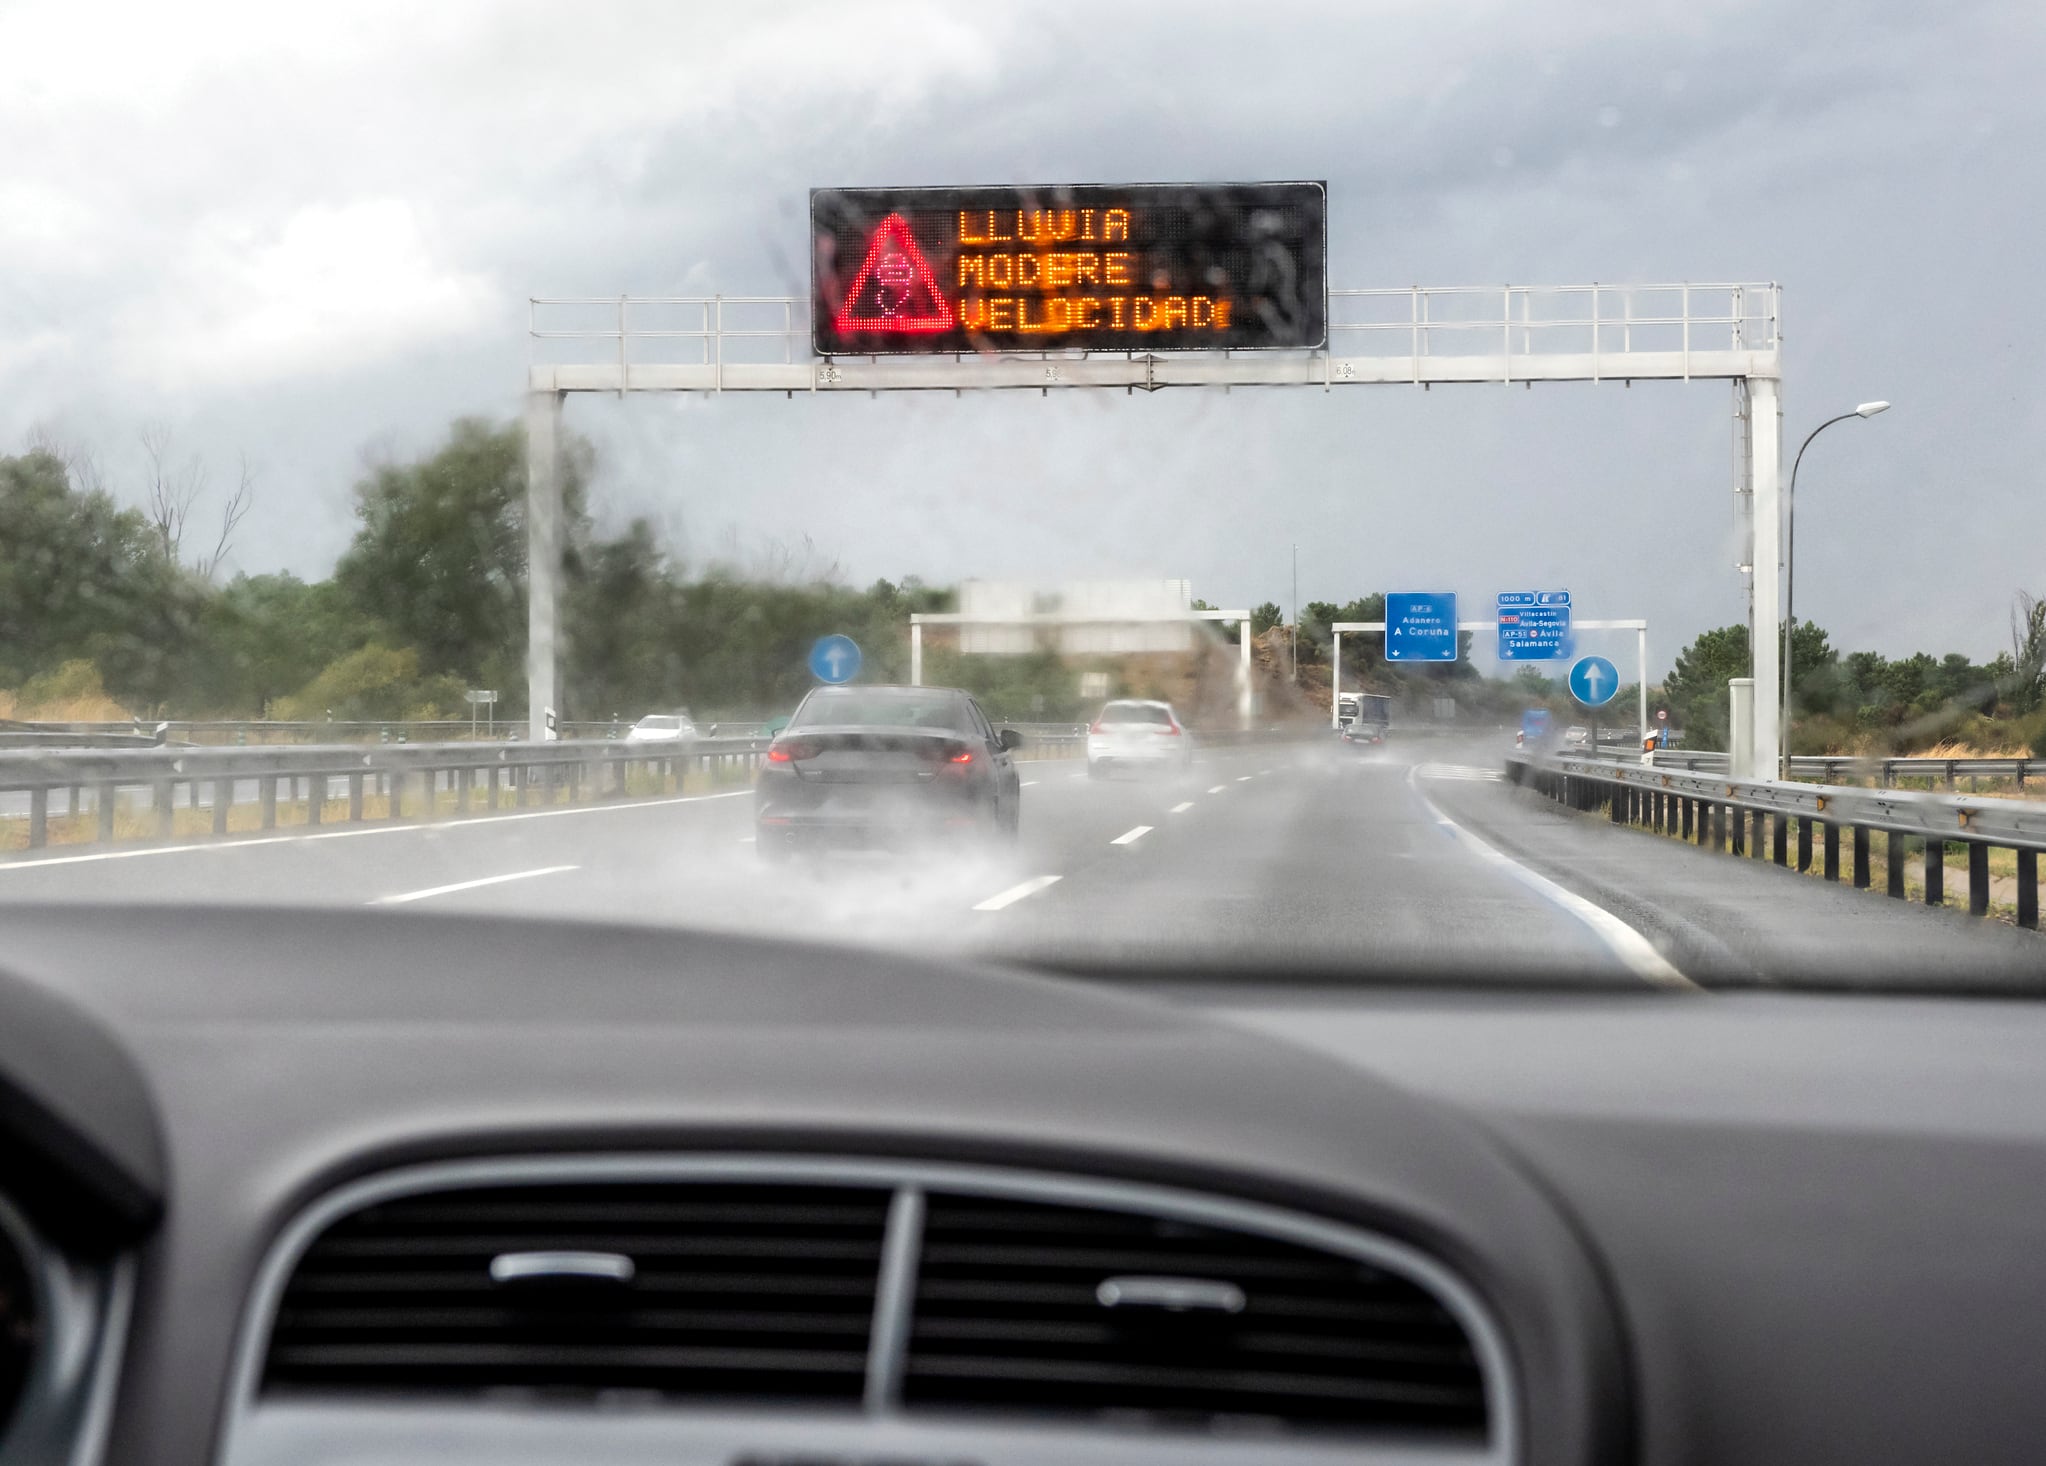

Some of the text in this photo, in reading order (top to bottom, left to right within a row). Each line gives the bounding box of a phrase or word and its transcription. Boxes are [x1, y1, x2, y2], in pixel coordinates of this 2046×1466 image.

[960, 208, 1128, 241] LLUVIA
[960, 252, 1128, 287] MODERE
[961, 296, 1215, 329] VELOCIDAD
[1402, 616, 1441, 624] Adanero
[1394, 626, 1449, 636] A Coruña
[1509, 640, 1560, 648] Salamanca
